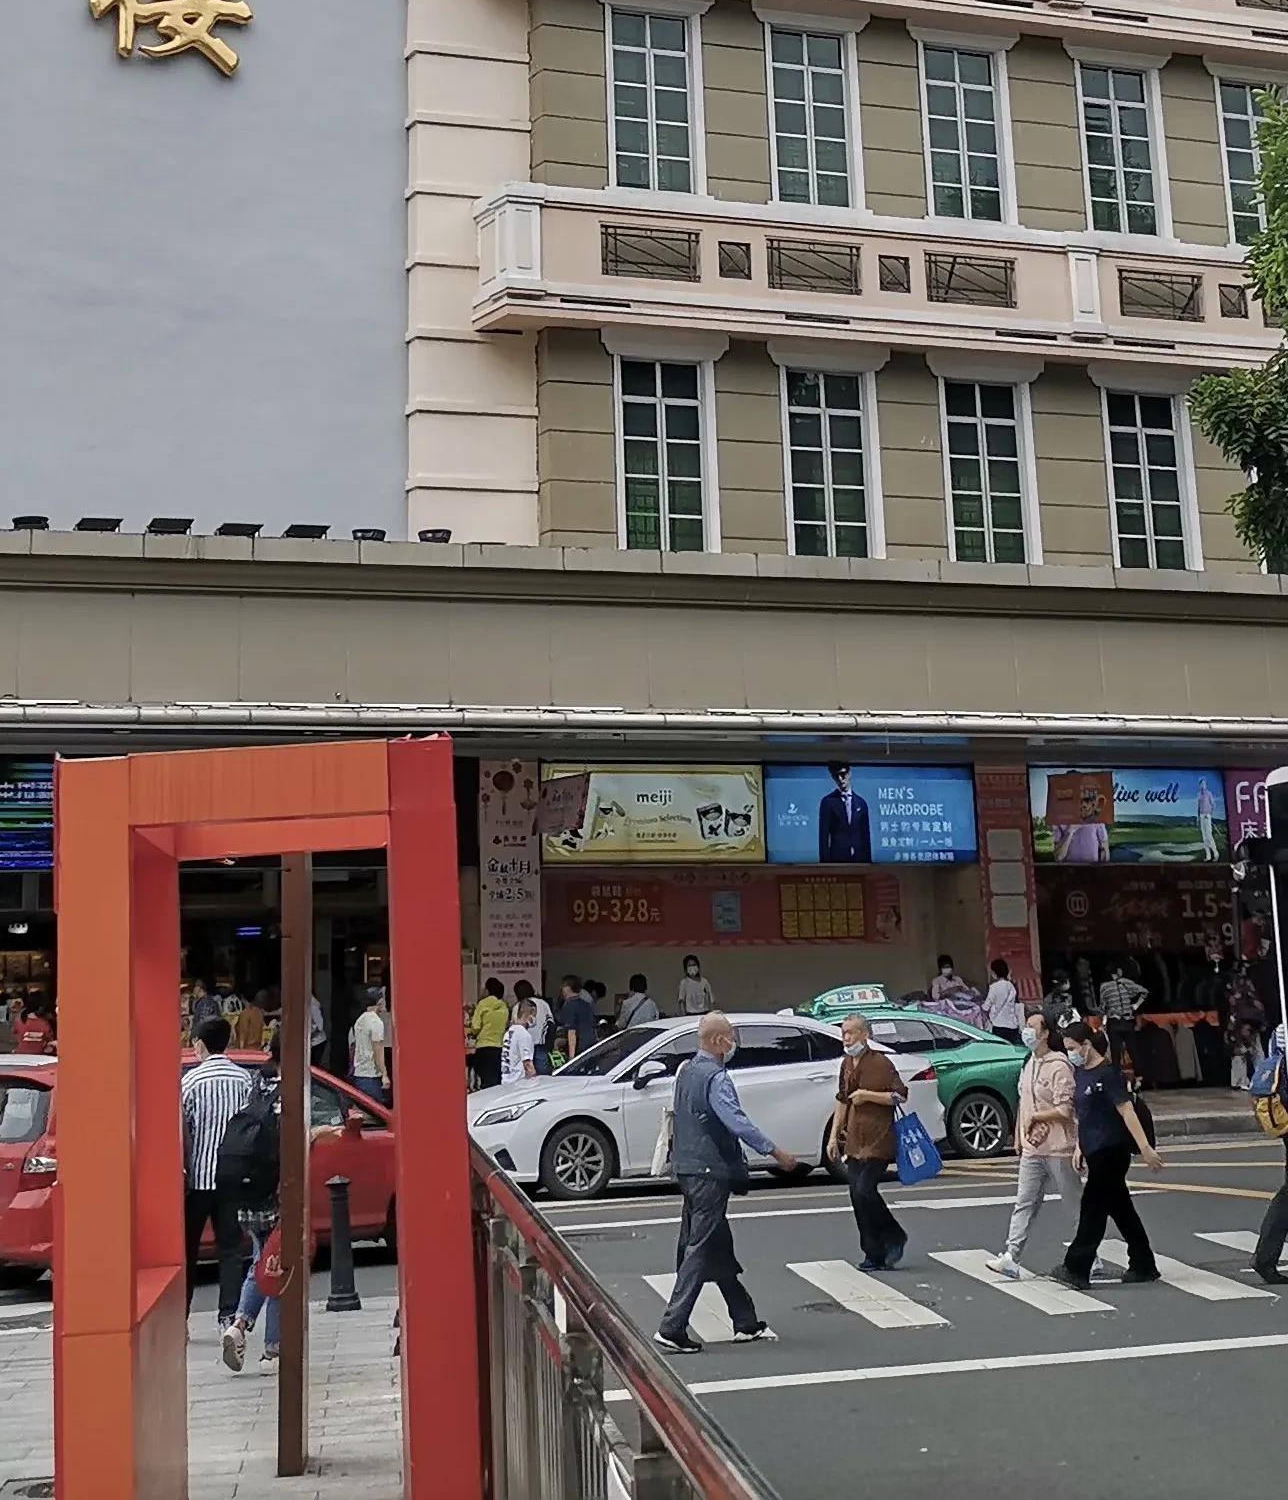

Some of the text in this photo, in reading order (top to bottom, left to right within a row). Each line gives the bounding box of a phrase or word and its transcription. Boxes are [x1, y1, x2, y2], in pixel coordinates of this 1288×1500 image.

[636, 789, 672, 806] meiji
[878, 787, 915, 800] MEN'S
[1145, 781, 1180, 803] well
[879, 803, 944, 816] WARDROBE
